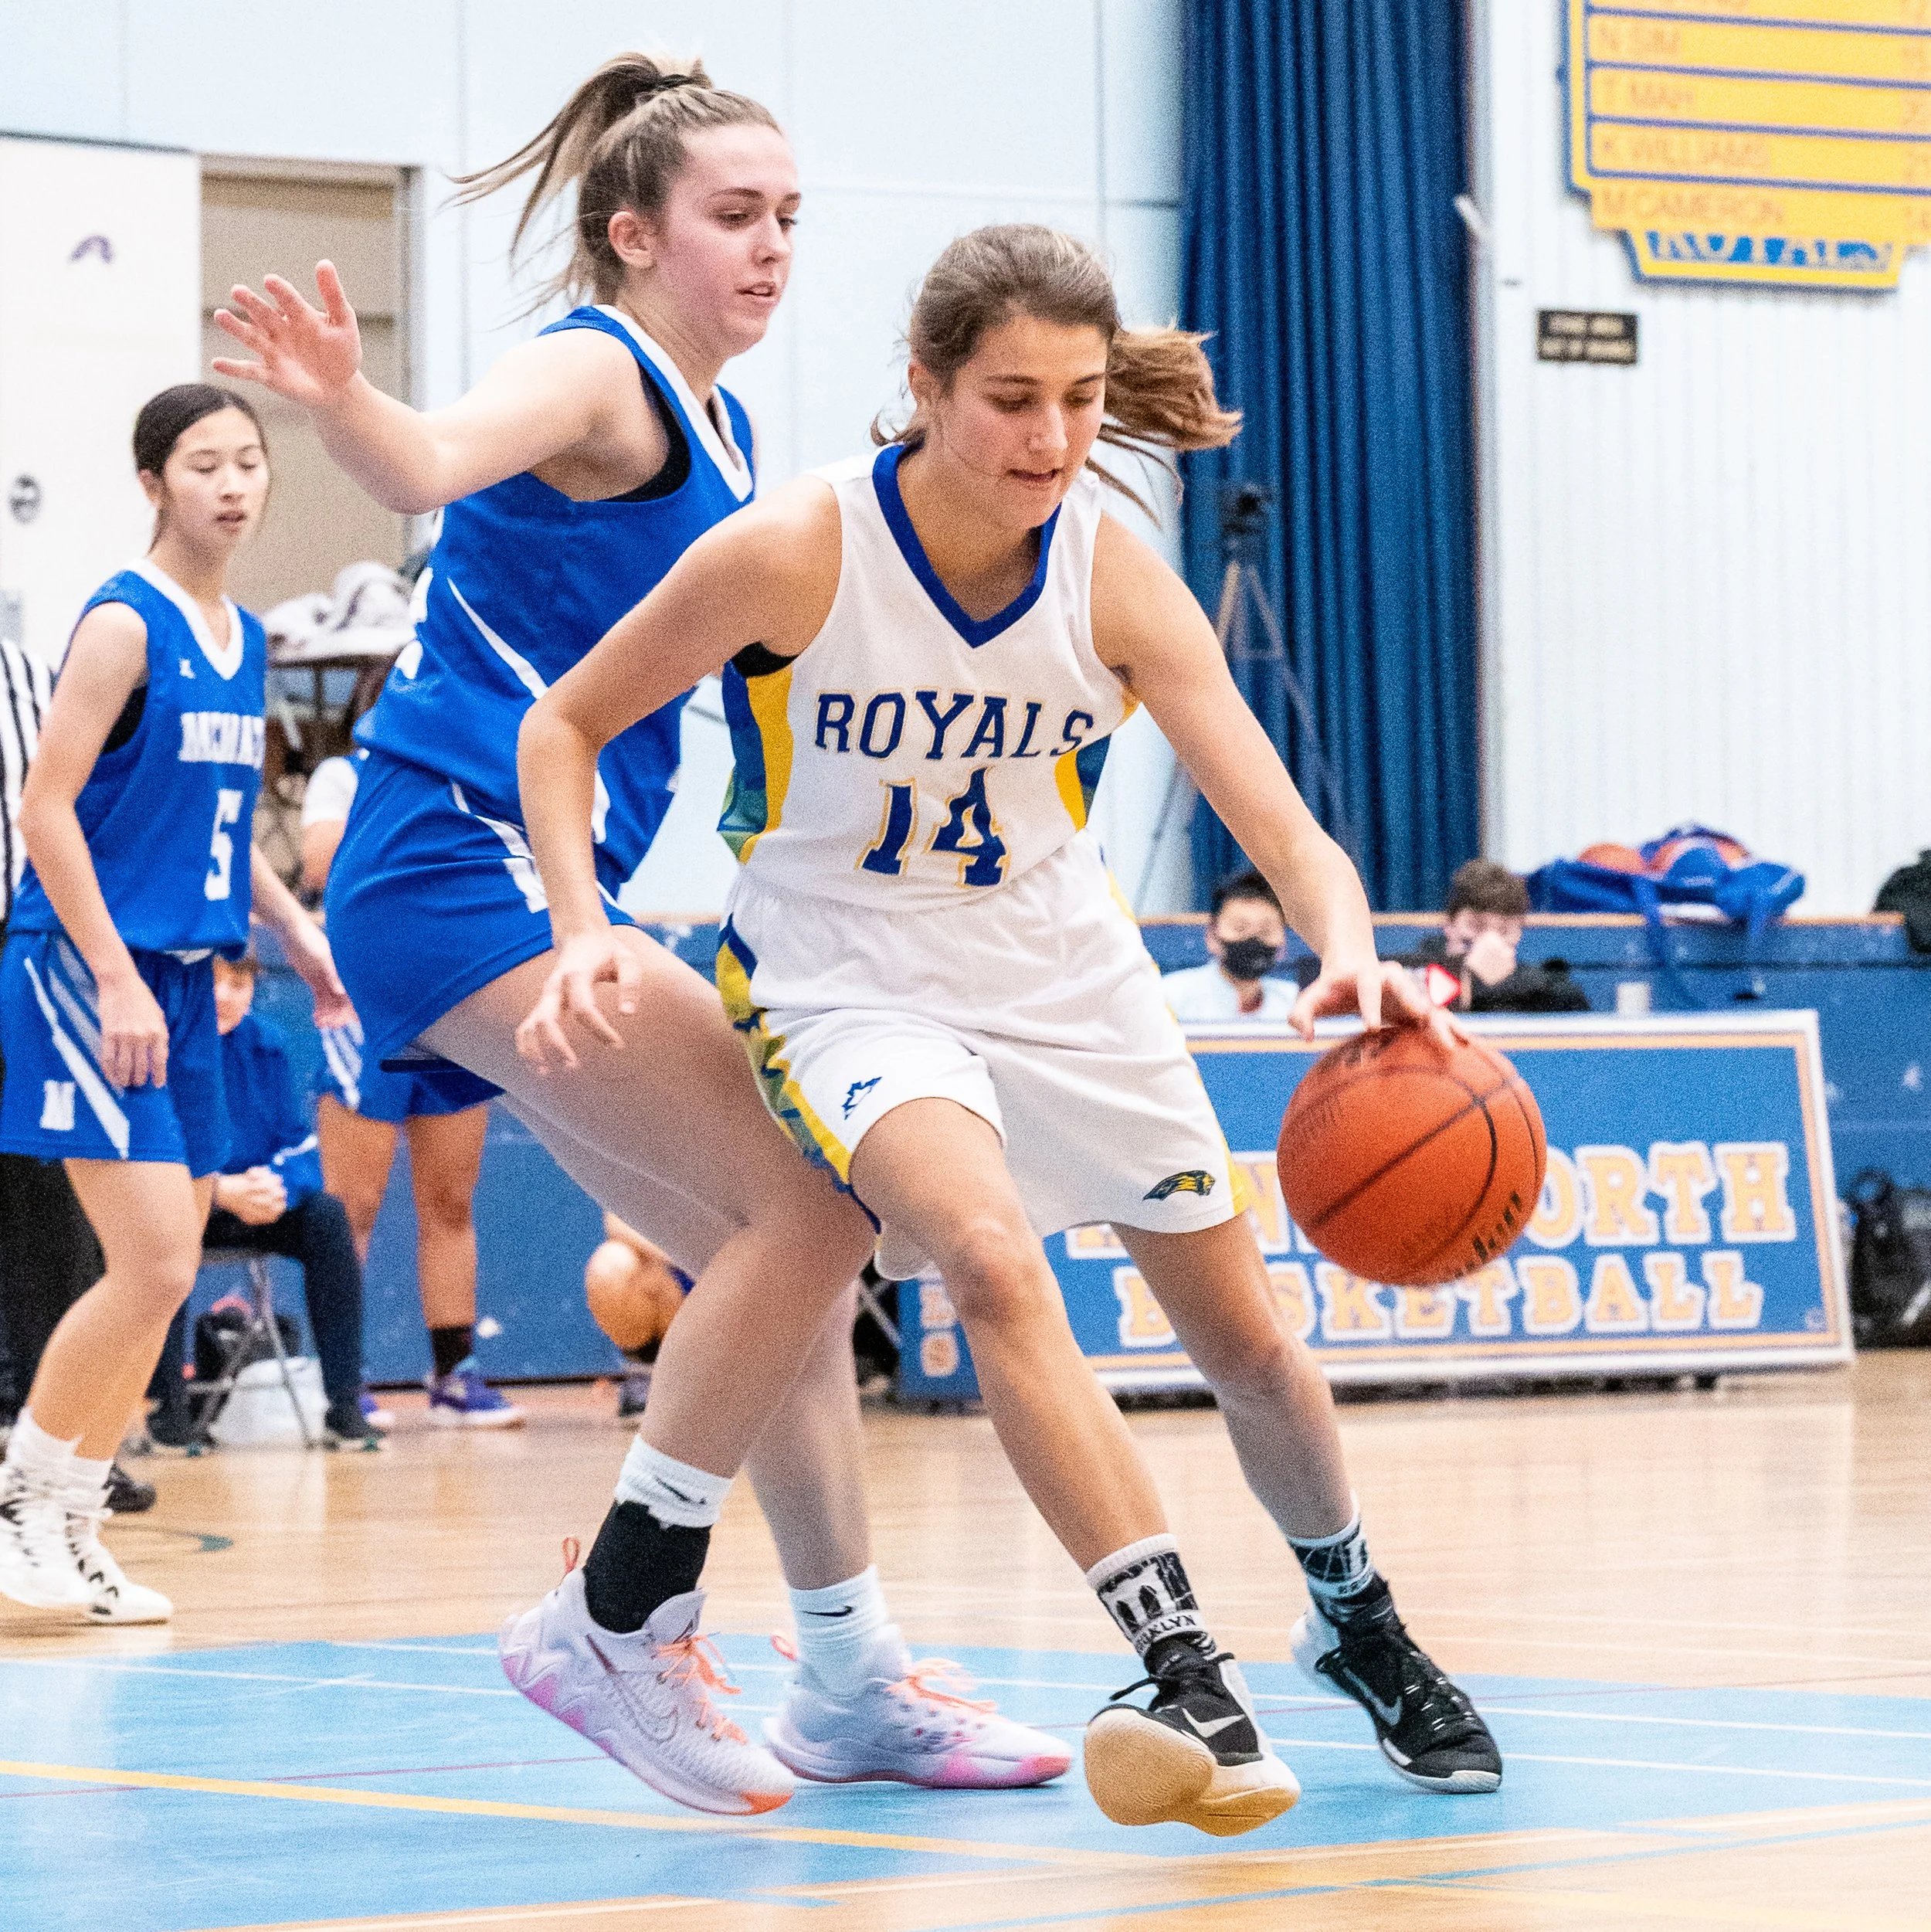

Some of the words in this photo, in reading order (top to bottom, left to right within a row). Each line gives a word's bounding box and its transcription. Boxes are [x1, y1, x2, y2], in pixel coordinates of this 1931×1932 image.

[814, 686, 1096, 761] ROYALS
[204, 789, 243, 901] 5
[856, 767, 1010, 888] 14
[1113, 1250, 1764, 1349] BSKETBALL
